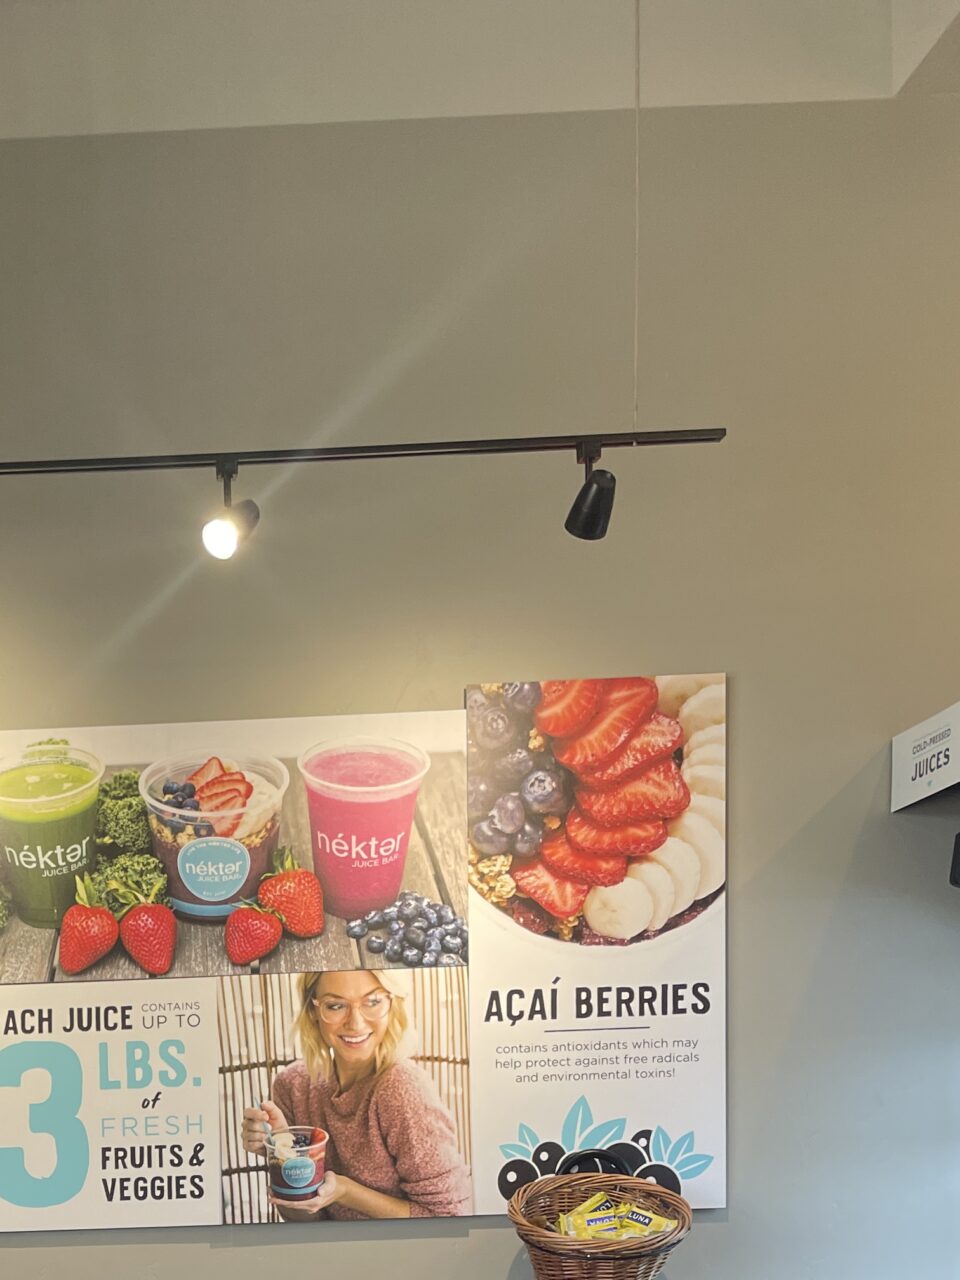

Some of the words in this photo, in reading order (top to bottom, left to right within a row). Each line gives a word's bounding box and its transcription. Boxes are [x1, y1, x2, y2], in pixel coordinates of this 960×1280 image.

[911, 747, 950, 781] JUICES
[41, 866, 69, 877] JUICE
[351, 859, 379, 868] JUICE
[141, 1001, 201, 1012] CONTAINS
[484, 976, 561, 1027] AÇAÍ
[575, 982, 710, 1018] BERRIES
[62, 1005, 133, 1033] JUICE
[142, 1015, 167, 1029] UP
[175, 1013, 201, 1028] TO
[495, 1042, 548, 1054] contains
[551, 1040, 628, 1053] antioxidants
[632, 1038, 669, 1050] which
[672, 1039, 699, 1050] may
[98, 1039, 202, 1090] LBS.
[495, 1058, 522, 1071] help
[525, 1056, 572, 1070] protect
[575, 1055, 620, 1068] against
[623, 1054, 648, 1065] free
[652, 1052, 700, 1063] radicals
[515, 1071, 539, 1083] and
[542, 1069, 631, 1082] environmental
[635, 1068, 675, 1079] toxins!
[141, 1091, 162, 1109] of
[101, 1114, 203, 1137] FRESH
[101, 1144, 183, 1170] FRUITS
[188, 1143, 205, 1167] &
[101, 1174, 204, 1202] VEGGIES
[628, 1211, 650, 1225] LUNA
